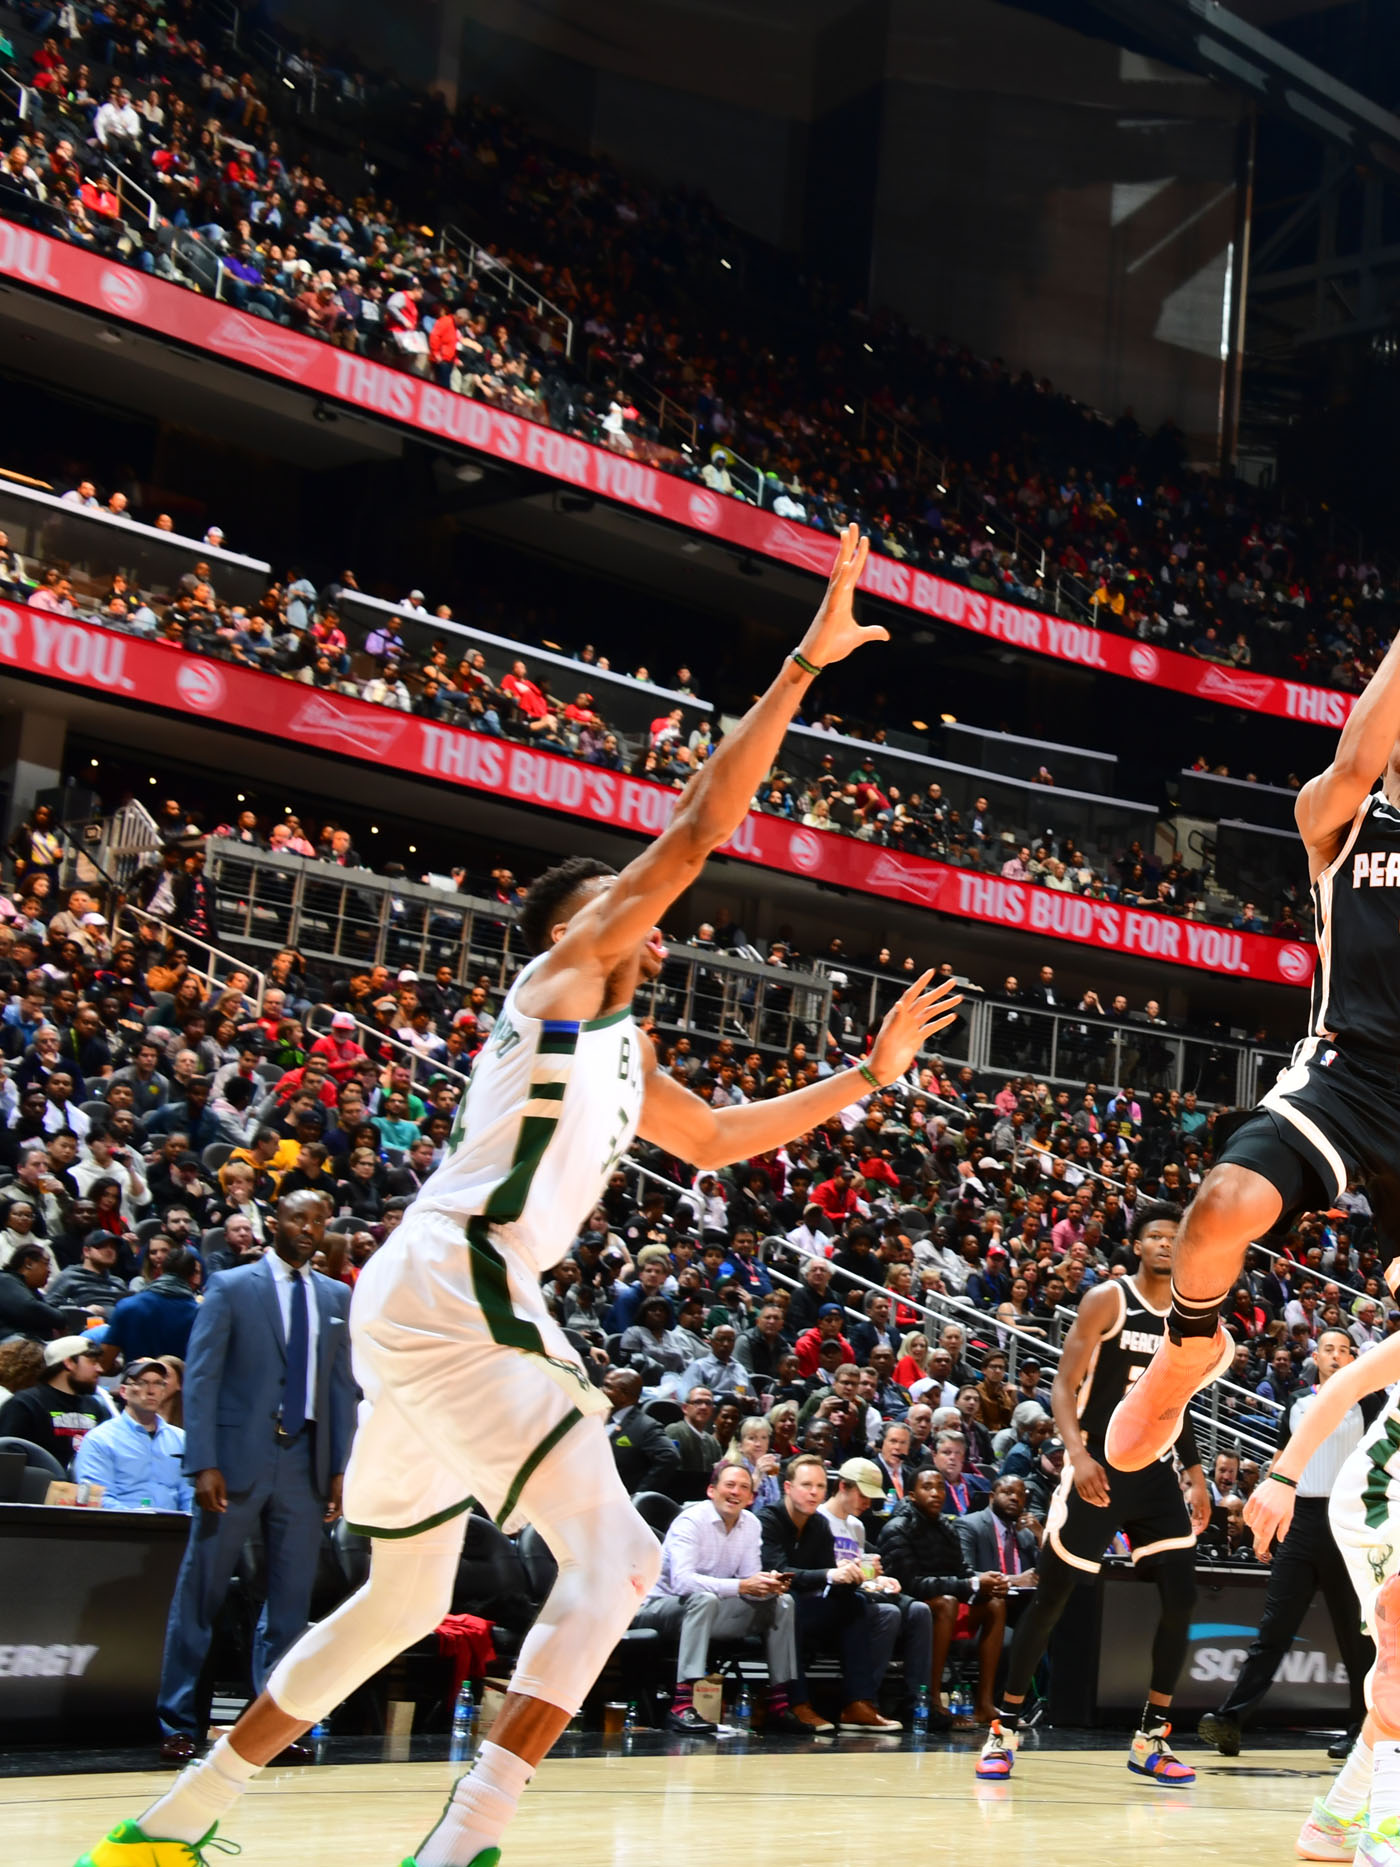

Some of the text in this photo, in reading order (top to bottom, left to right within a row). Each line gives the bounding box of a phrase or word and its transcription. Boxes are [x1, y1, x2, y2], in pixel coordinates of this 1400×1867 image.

[334, 353, 662, 511] THIS BUD'S FOR YOU.
[30, 614, 135, 691] YOU.
[857, 552, 1106, 668] HIS BUD'S FOR YOU.
[1282, 682, 1346, 725] THIS
[420, 723, 504, 788] THIS
[509, 748, 614, 817] BUD'S
[956, 872, 1025, 923] THIS
[1030, 889, 1120, 944] BUD'S
[1124, 912, 1179, 958] FOR
[1186, 924, 1250, 973] YOU.
[1190, 1647, 1327, 1684] SCNA
